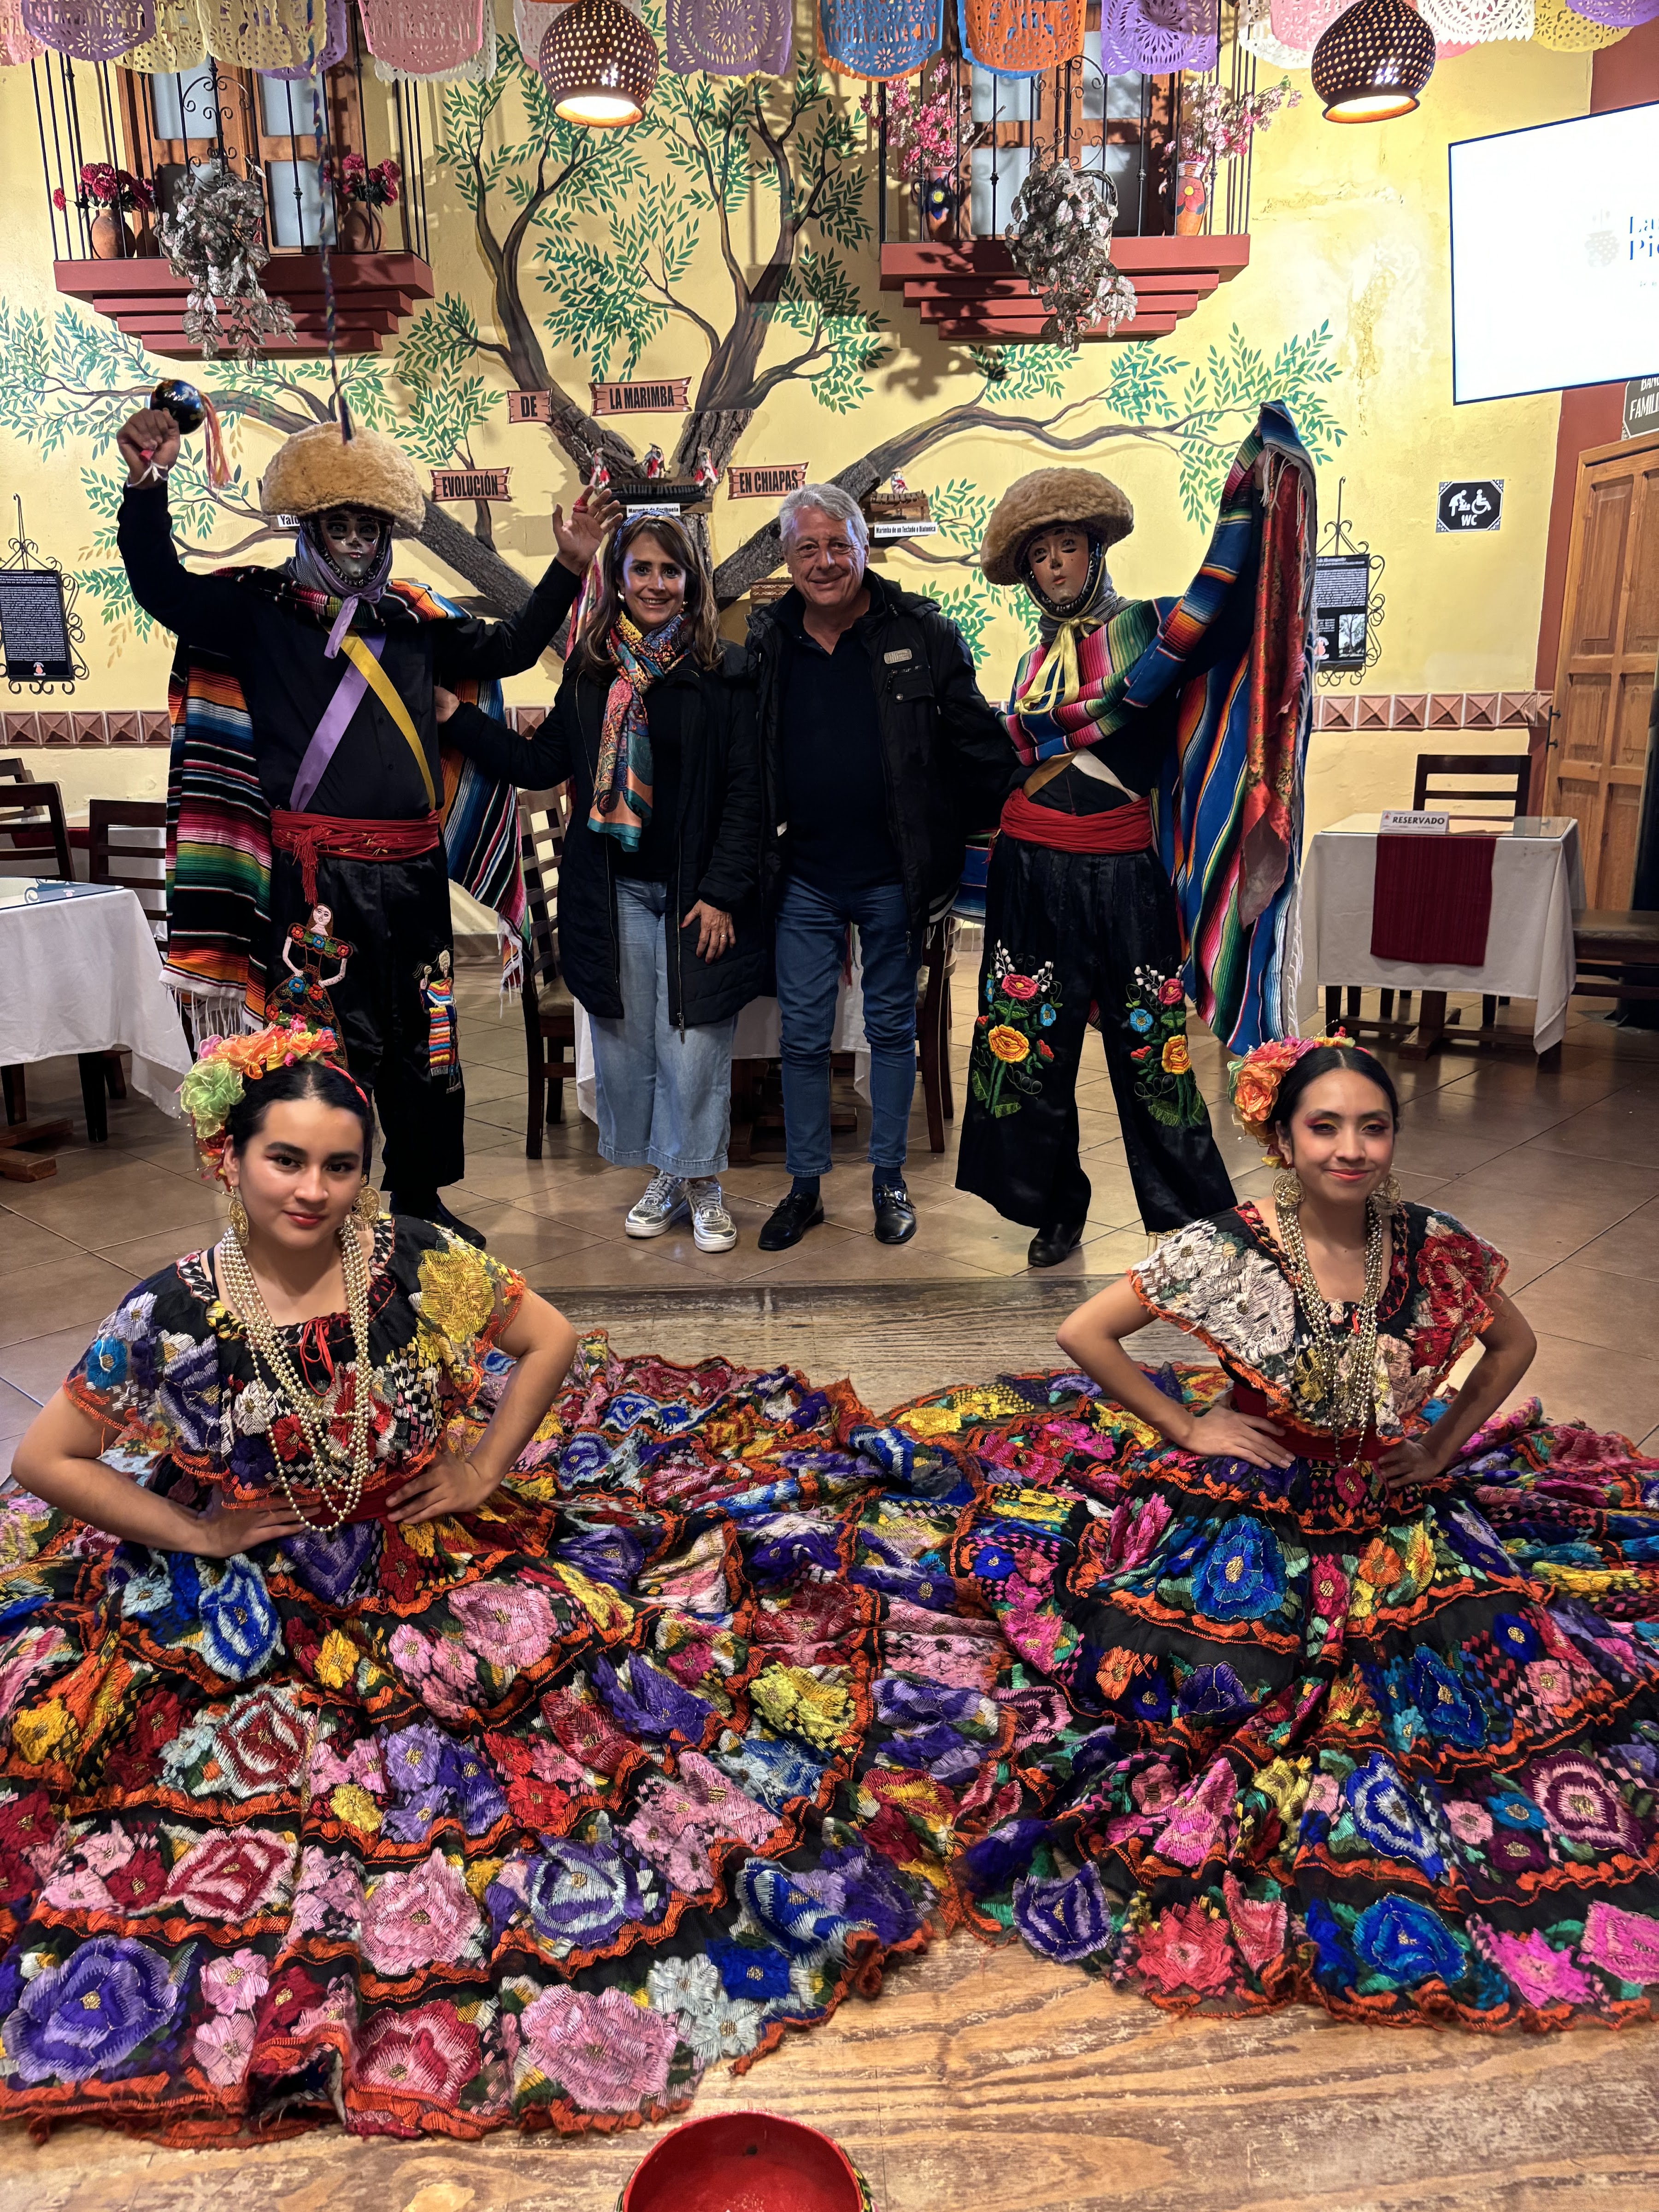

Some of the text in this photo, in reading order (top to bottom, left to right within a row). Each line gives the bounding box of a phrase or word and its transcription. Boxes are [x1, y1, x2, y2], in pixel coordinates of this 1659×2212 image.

[520, 395, 538, 417] DE
[609, 385, 675, 409] LA MARIMBA
[442, 471, 498, 497] EVOLUCIÓN
[739, 470, 799, 493] EN CHIAPAS
[1461, 514, 1477, 526] WC
